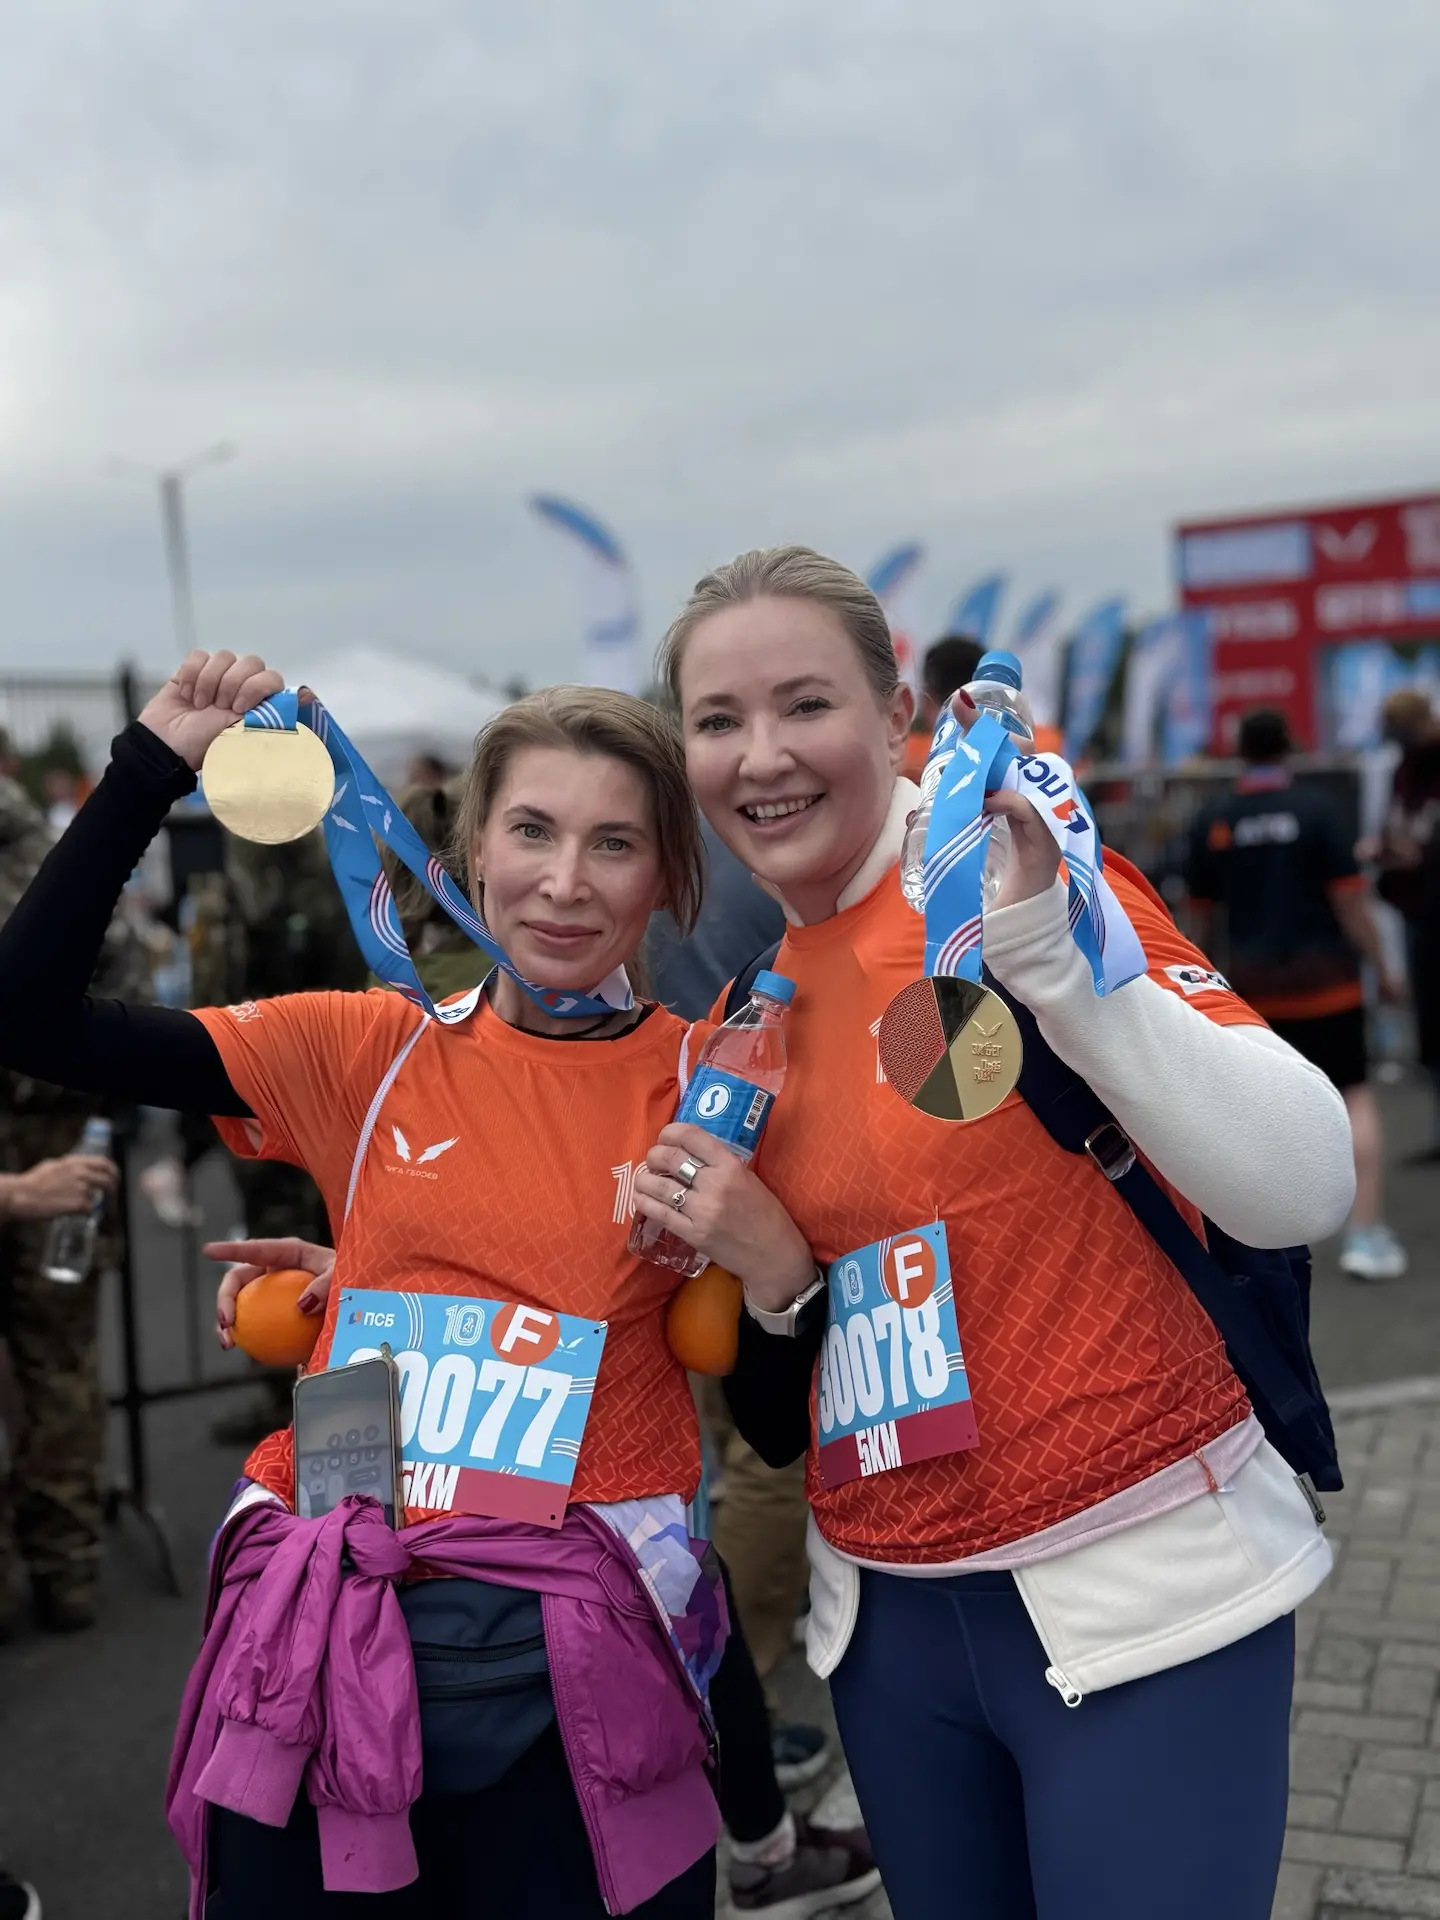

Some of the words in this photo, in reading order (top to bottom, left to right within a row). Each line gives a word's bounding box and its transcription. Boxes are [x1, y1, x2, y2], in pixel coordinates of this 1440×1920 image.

[893, 1241, 923, 1301] F
[363, 1311, 395, 1328] ПСБ
[499, 1304, 553, 1353] F
[819, 1295, 950, 1434] 30078
[347, 1347, 573, 1468] 0077
